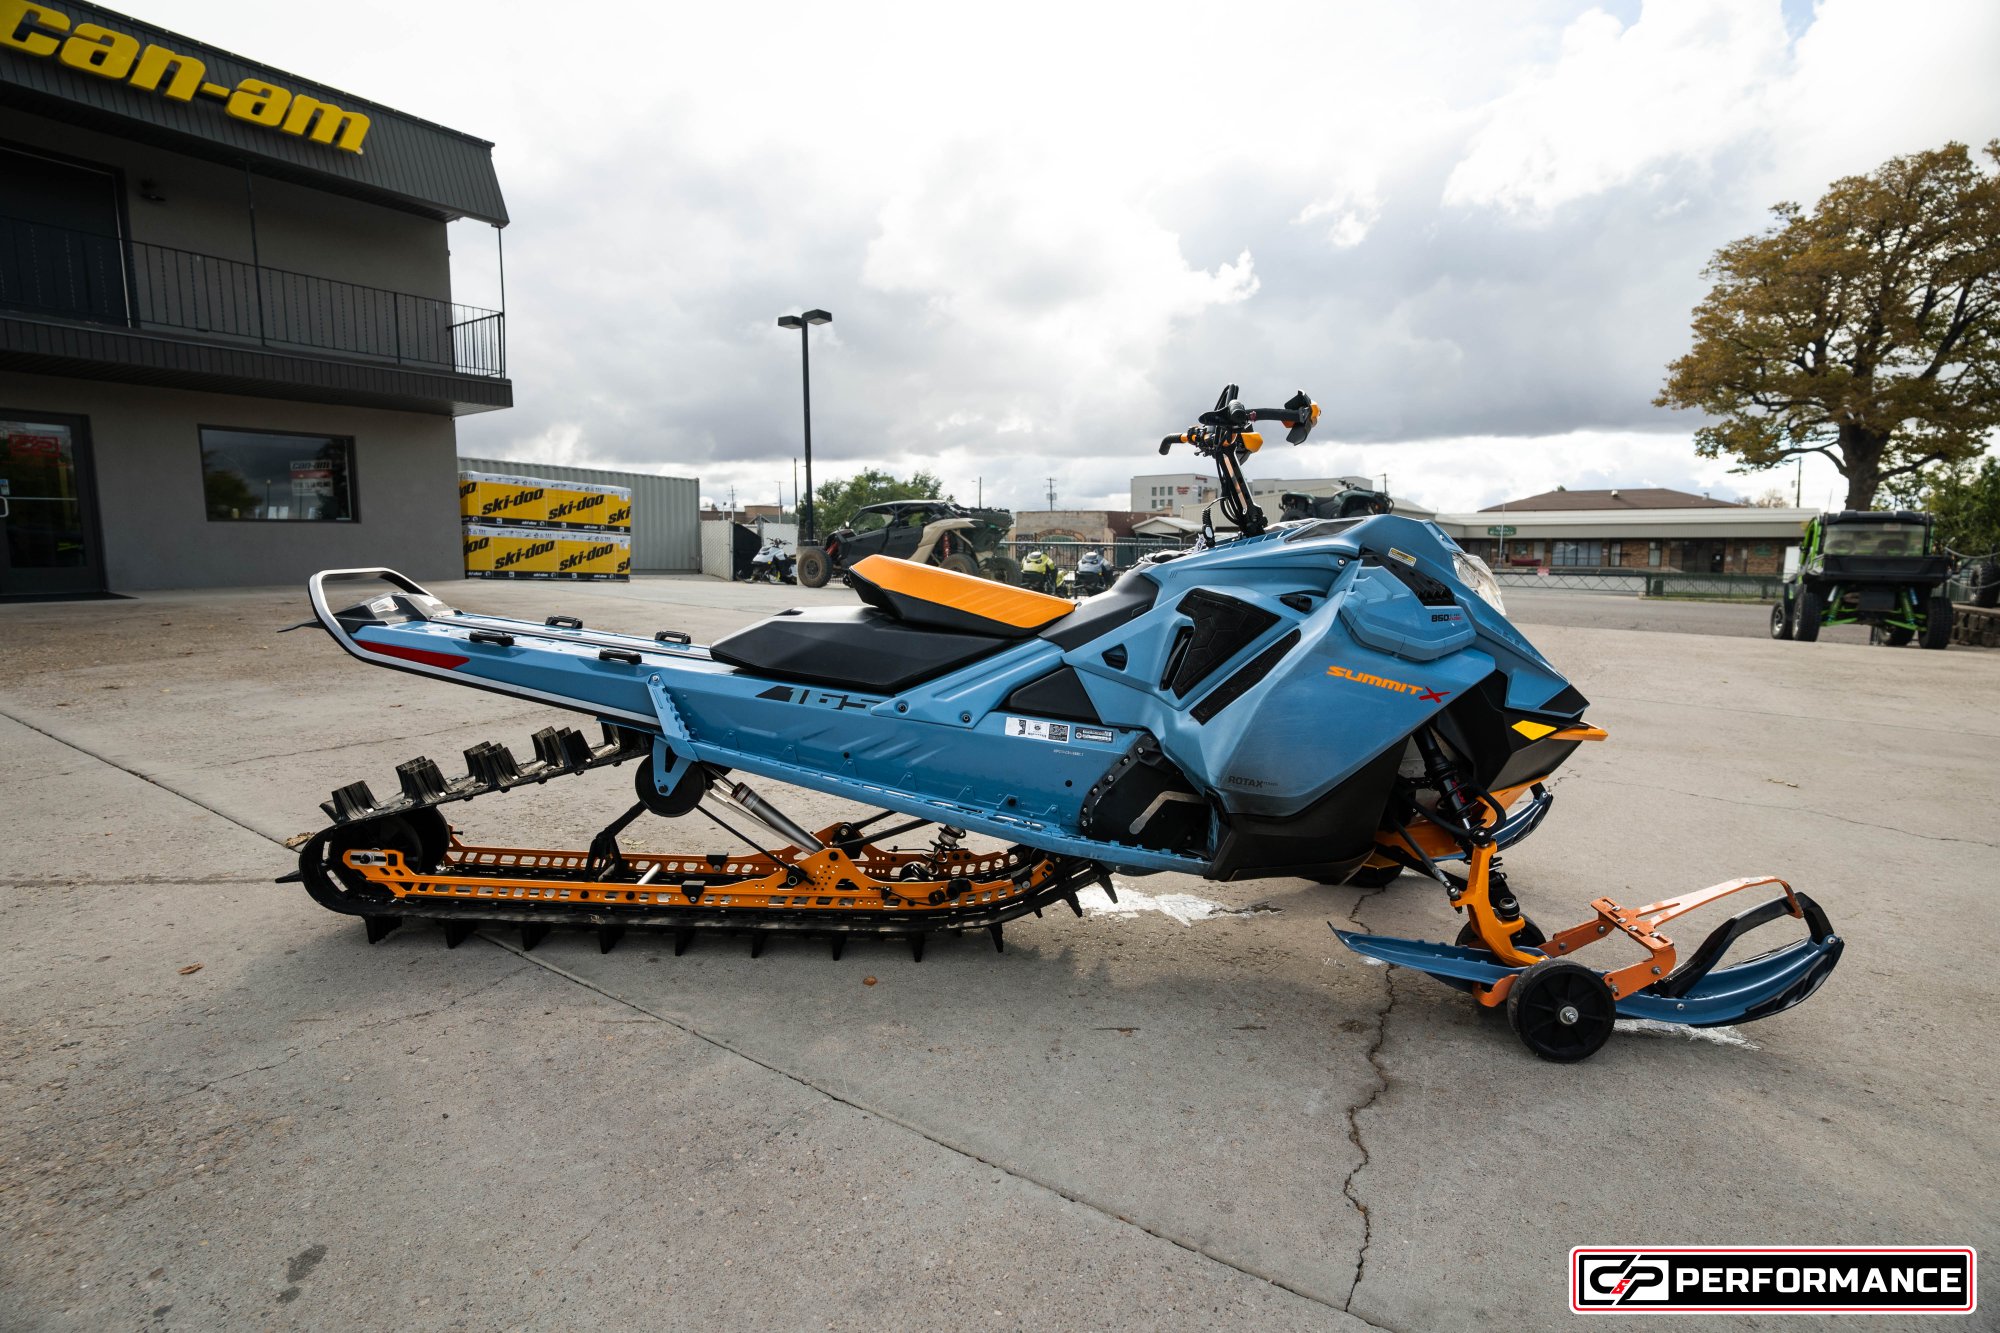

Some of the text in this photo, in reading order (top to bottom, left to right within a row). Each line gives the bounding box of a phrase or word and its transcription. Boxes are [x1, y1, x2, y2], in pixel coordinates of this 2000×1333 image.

[0, 0, 371, 152] can-am
[482, 488, 545, 515] ski-doo
[548, 494, 605, 520] ski-doo
[494, 541, 555, 569] ski-doo
[559, 544, 614, 571] ski-doo
[1431, 614, 1450, 622] 850
[1327, 666, 1451, 703] SUMMIT X
[1229, 775, 1263, 788] ROTAX
